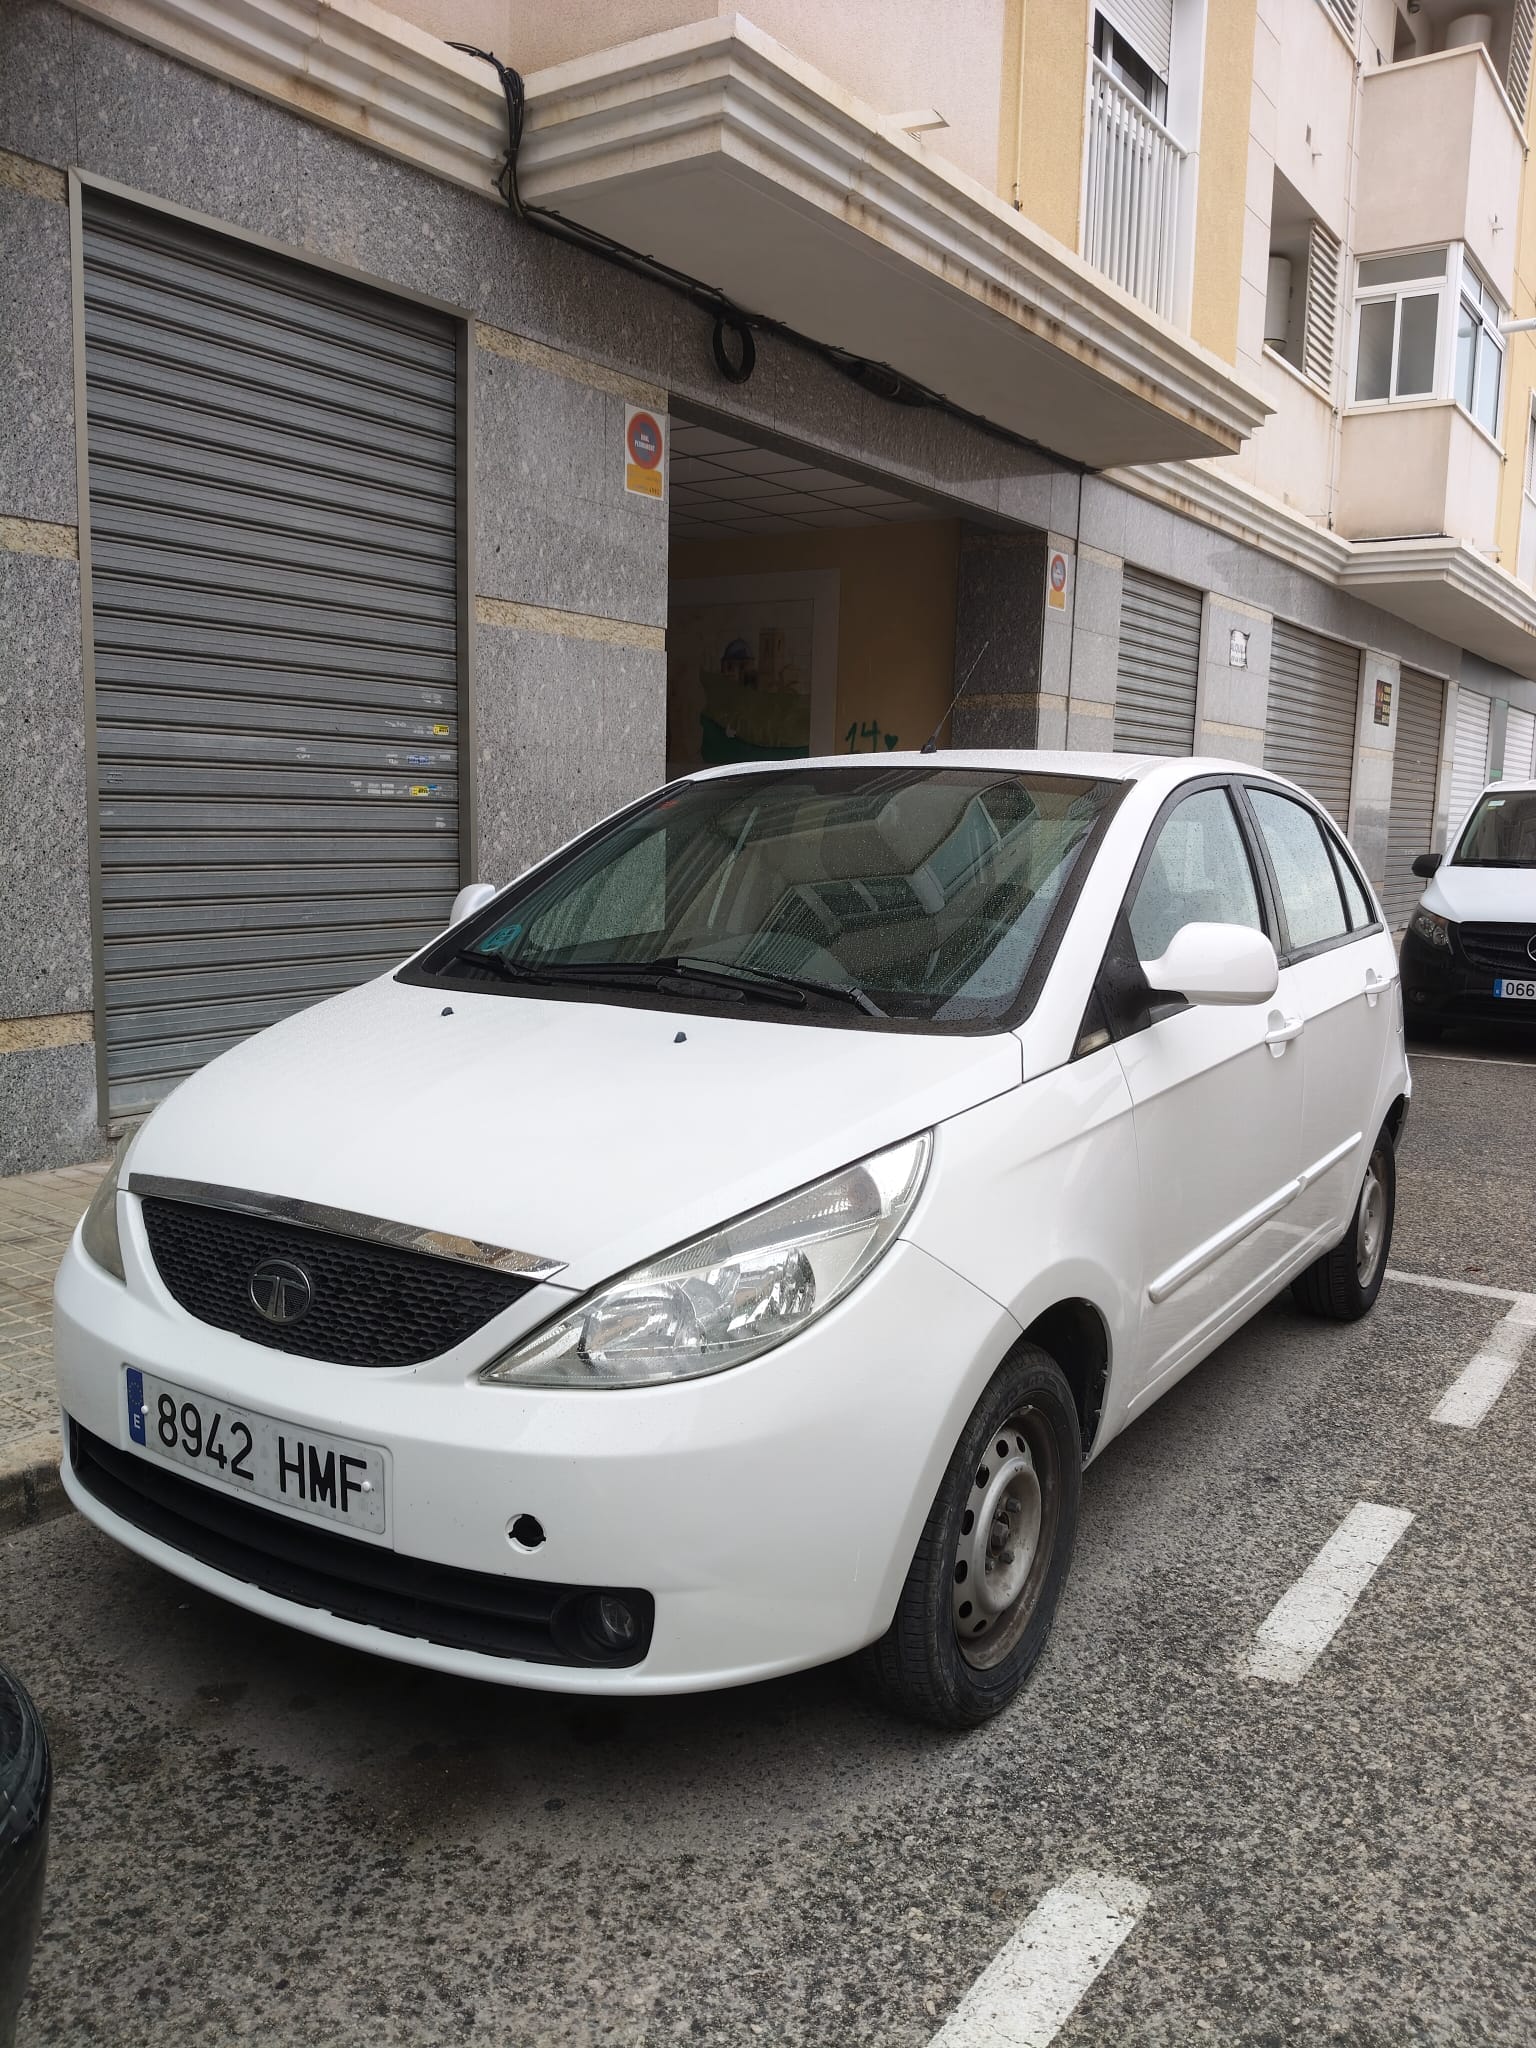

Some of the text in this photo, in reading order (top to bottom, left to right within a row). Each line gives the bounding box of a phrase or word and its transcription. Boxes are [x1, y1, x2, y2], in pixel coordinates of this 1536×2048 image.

[845, 719, 881, 752] 14
[1505, 982, 1535, 997] 066
[133, 1413, 141, 1430] E
[157, 1393, 368, 1513] 8942 HMF
